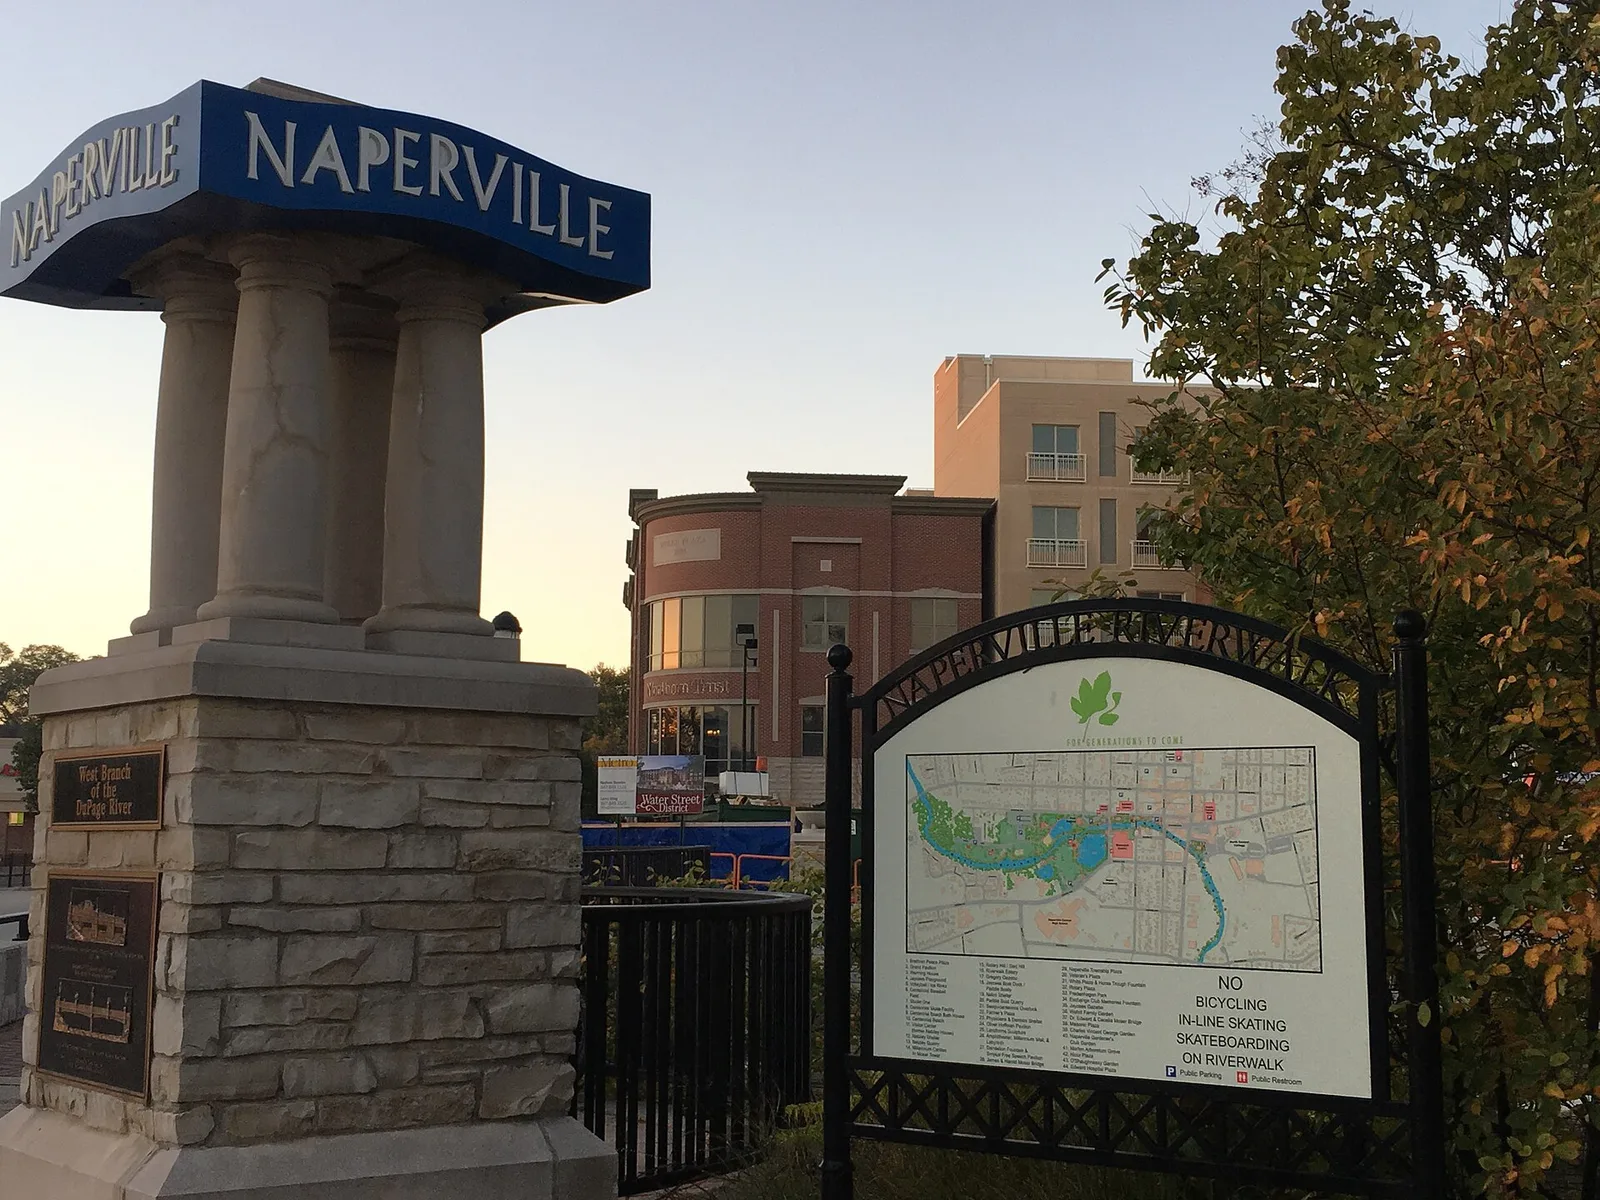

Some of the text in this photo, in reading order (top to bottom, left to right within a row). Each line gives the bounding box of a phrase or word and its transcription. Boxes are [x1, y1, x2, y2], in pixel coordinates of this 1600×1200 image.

[10, 113, 181, 268] NAPERVILLE
[243, 110, 616, 260] NAPERVILLE
[880, 610, 1096, 714] NAPERVILLE
[1066, 736, 1184, 747] FOR GENERATIONS TO COME
[79, 762, 132, 782] West Branch
[90, 781, 117, 798] of the
[76, 798, 133, 820] DuPage River
[641, 794, 701, 805] Water Street
[659, 803, 689, 813] District
[1218, 975, 1243, 991] NO
[1196, 995, 1267, 1012] BICYCLING
[1178, 1013, 1287, 1032] IN-LINE SKATING
[1176, 1032, 1290, 1052] SKATEBOARDING
[1182, 1052, 1284, 1071] ON RIVERWALK
[1180, 1069, 1199, 1077] Public
[1199, 1071, 1223, 1080] Parking
[1251, 1075, 1271, 1084] Public
[1272, 1076, 1303, 1086] Restroom
